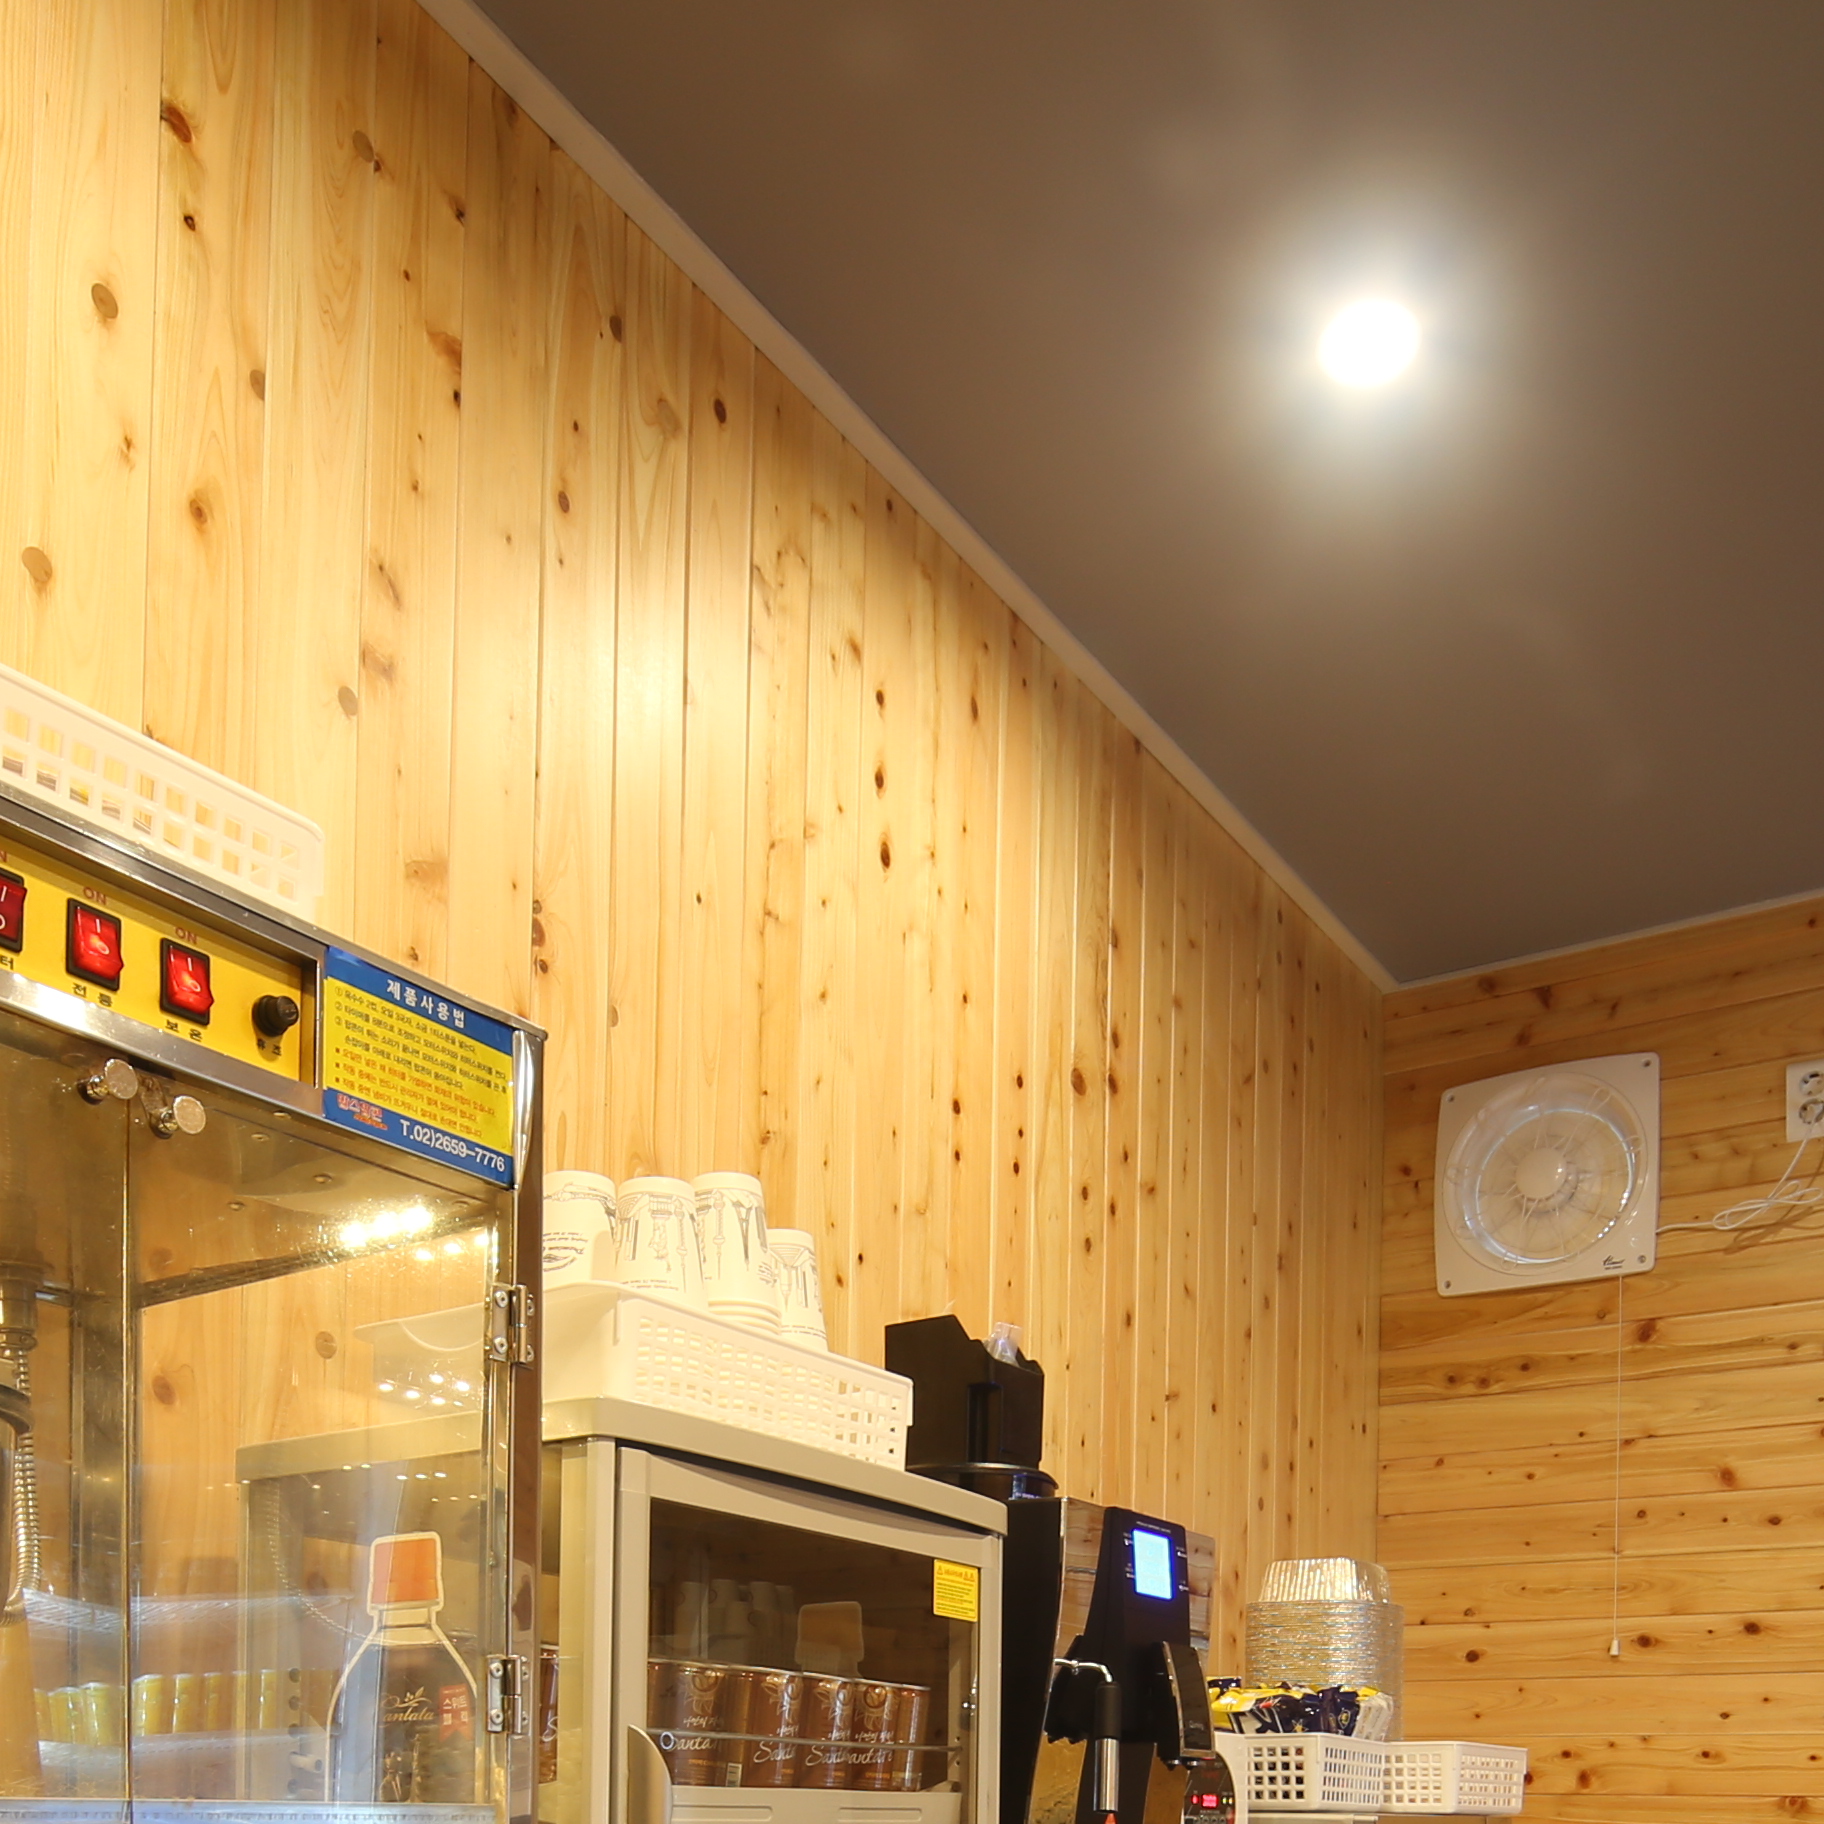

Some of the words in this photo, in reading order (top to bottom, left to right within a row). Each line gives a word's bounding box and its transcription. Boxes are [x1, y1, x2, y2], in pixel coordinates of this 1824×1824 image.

[83, 887, 107, 906] ON
[175, 926, 198, 945] ON
[387, 977, 464, 1029] 제품사용법
[400, 1119, 504, 1172] T.02)2659-7776
[442, 1695, 468, 1709] 스위트
